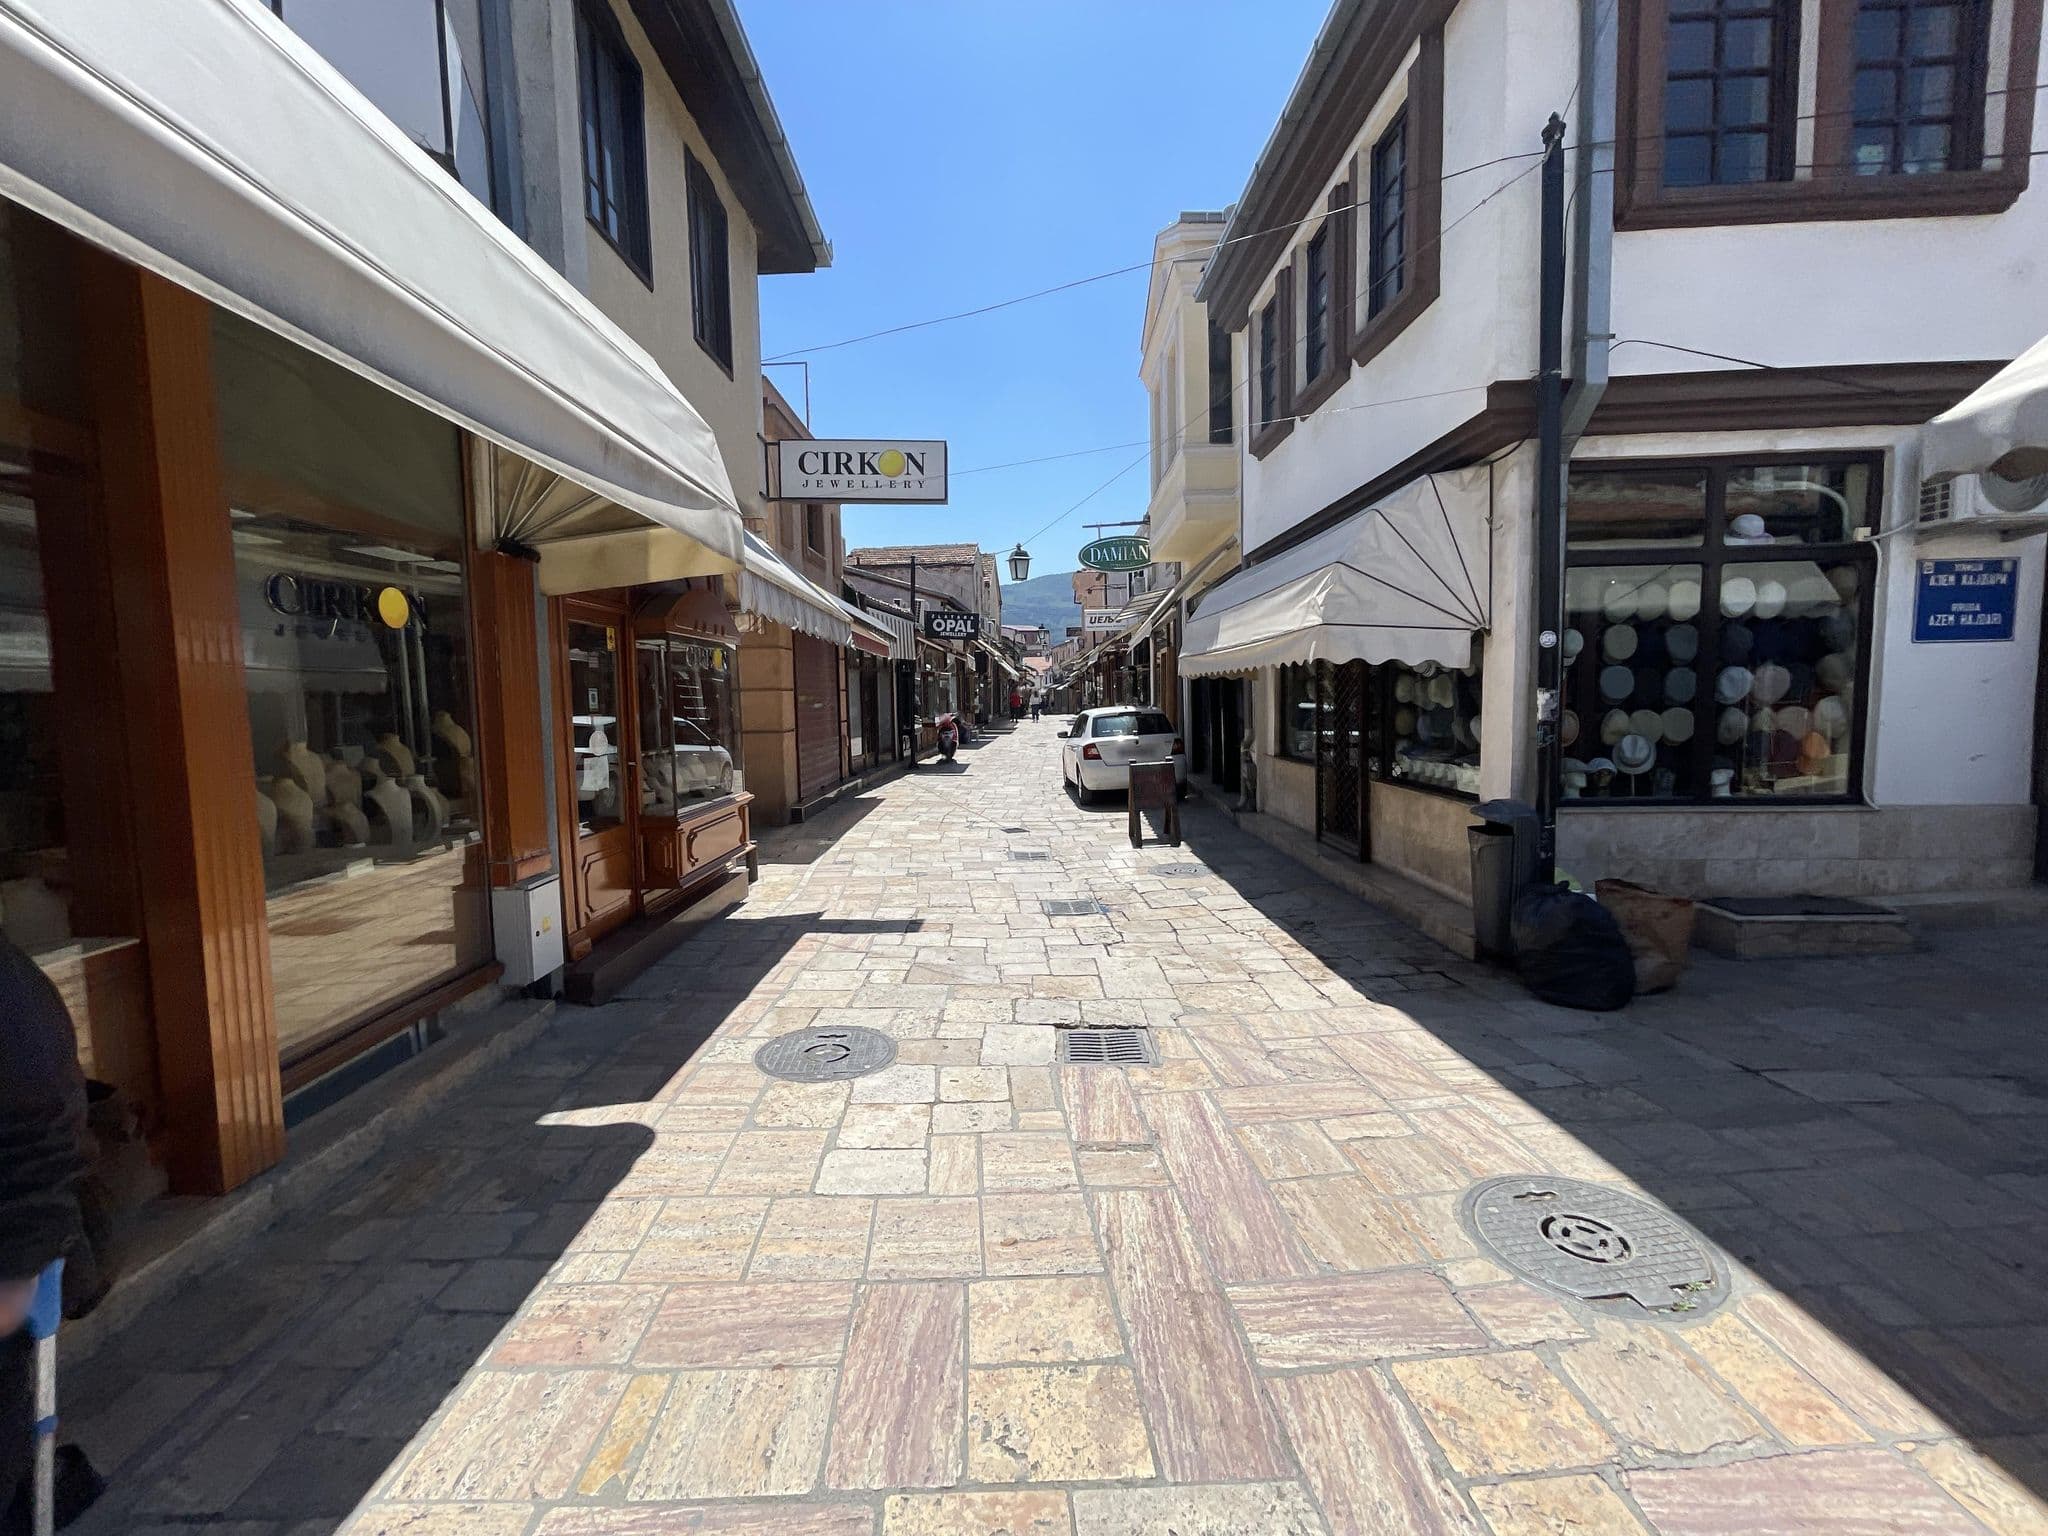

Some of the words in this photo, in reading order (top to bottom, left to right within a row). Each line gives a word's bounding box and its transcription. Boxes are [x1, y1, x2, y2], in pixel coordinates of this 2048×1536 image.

[798, 449, 926, 477] CIRKON
[802, 479, 925, 489] JEWELLERY
[1090, 545, 1149, 562] DAMIAN
[932, 619, 975, 633] OPAL
